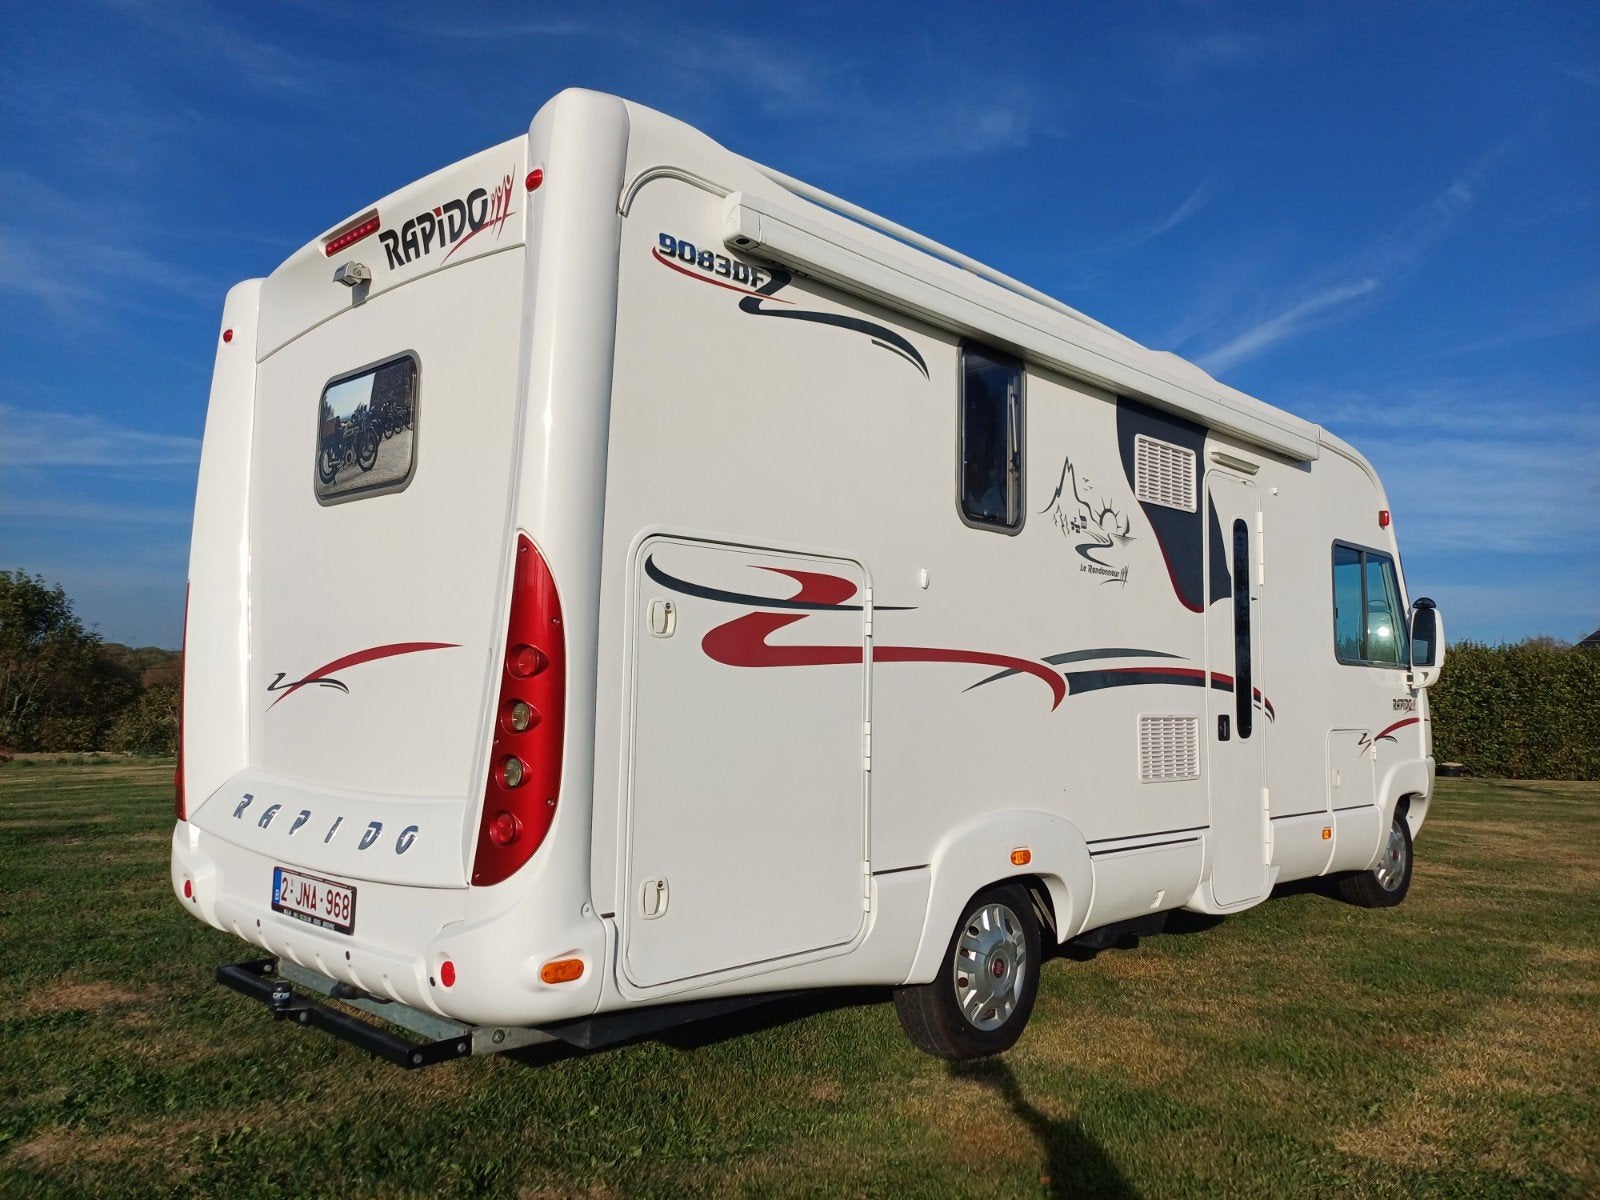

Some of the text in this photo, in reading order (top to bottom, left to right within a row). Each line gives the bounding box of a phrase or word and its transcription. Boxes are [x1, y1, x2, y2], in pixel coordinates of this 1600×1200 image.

[658, 232, 765, 288] 9083DF
[1080, 563, 1087, 571] Le
[232, 793, 419, 855] RAPIDO
